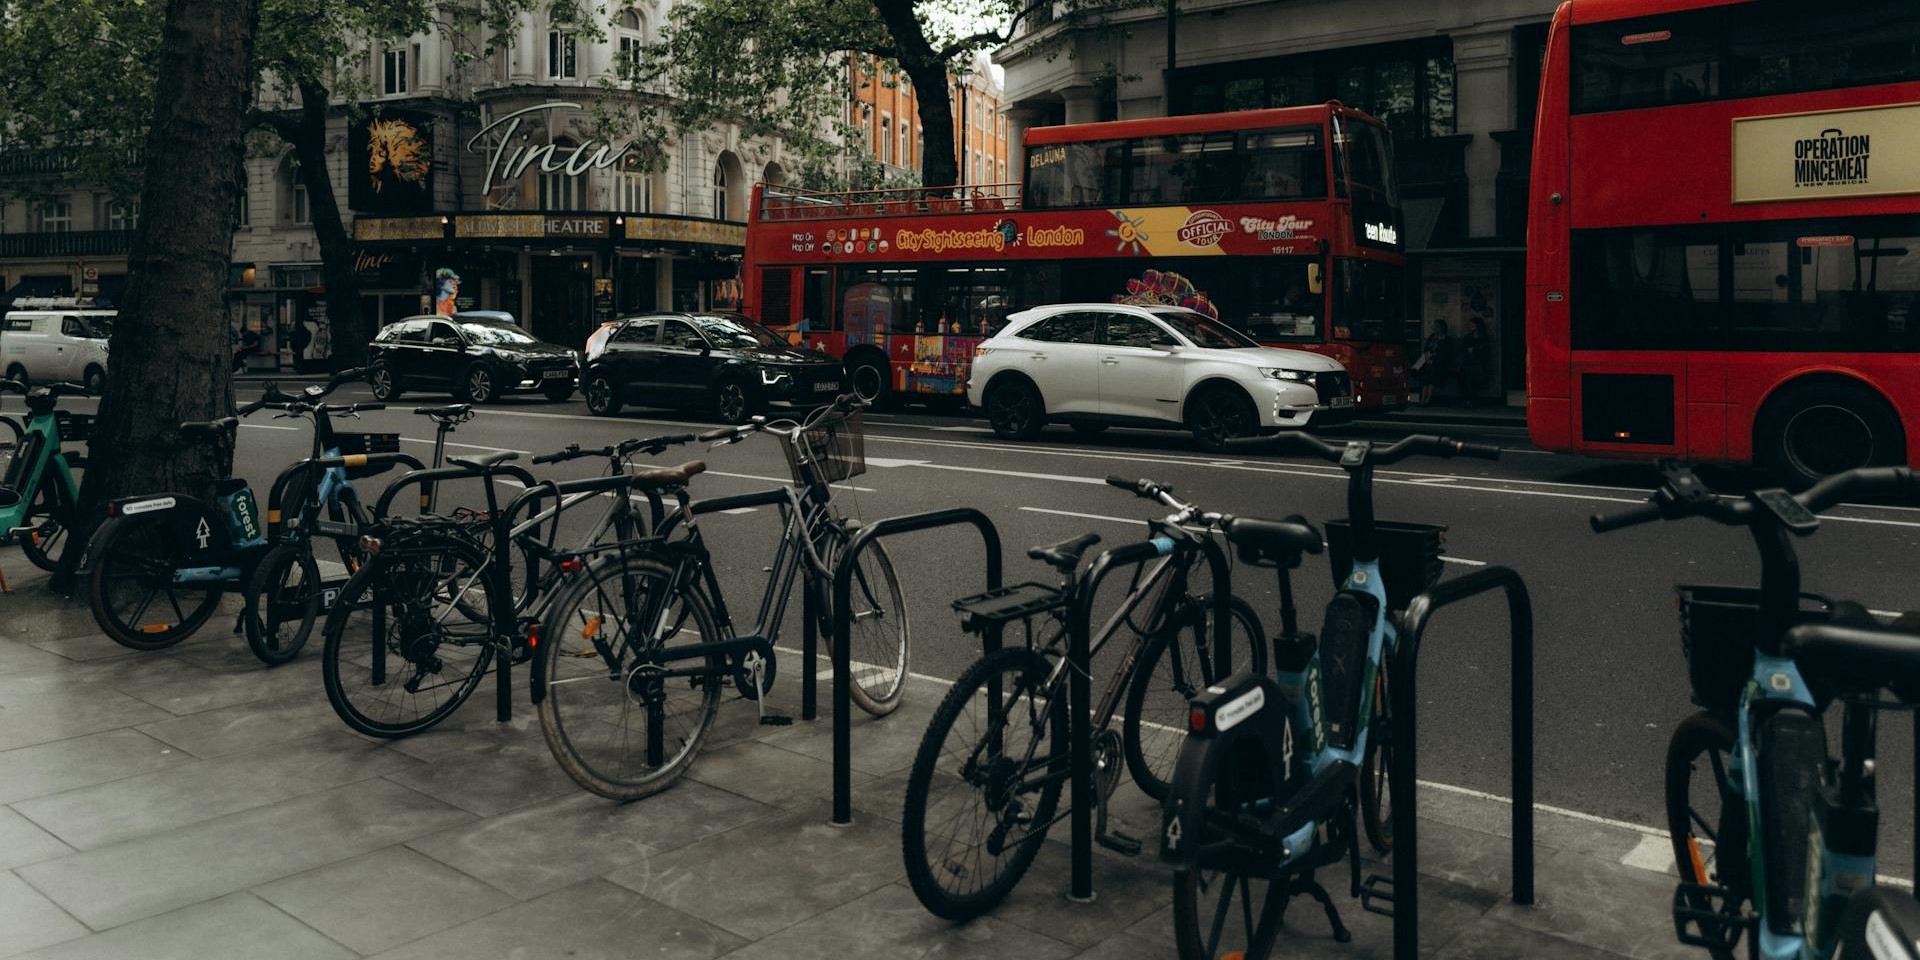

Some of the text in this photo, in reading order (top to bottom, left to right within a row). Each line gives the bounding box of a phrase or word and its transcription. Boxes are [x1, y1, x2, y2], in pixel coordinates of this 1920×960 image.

[467, 101, 634, 196] Tina
[1795, 135, 1869, 159] OPERATION
[1794, 154, 1869, 183] MINCEMEAT
[532, 219, 604, 234] THEATRE
[1181, 221, 1231, 240] OFFICIAL
[1239, 215, 1274, 233] City
[1277, 214, 1313, 232] Tour
[792, 232, 814, 241] Hop On
[896, 224, 1084, 253] CitySightseeing London
[1197, 234, 1219, 246] TOUR
[1258, 230, 1294, 241] LONDON
[1365, 222, 1397, 245] een Route
[792, 243, 815, 252] Hop Off
[1272, 246, 1294, 254] 15117
[236, 494, 258, 539] forest
